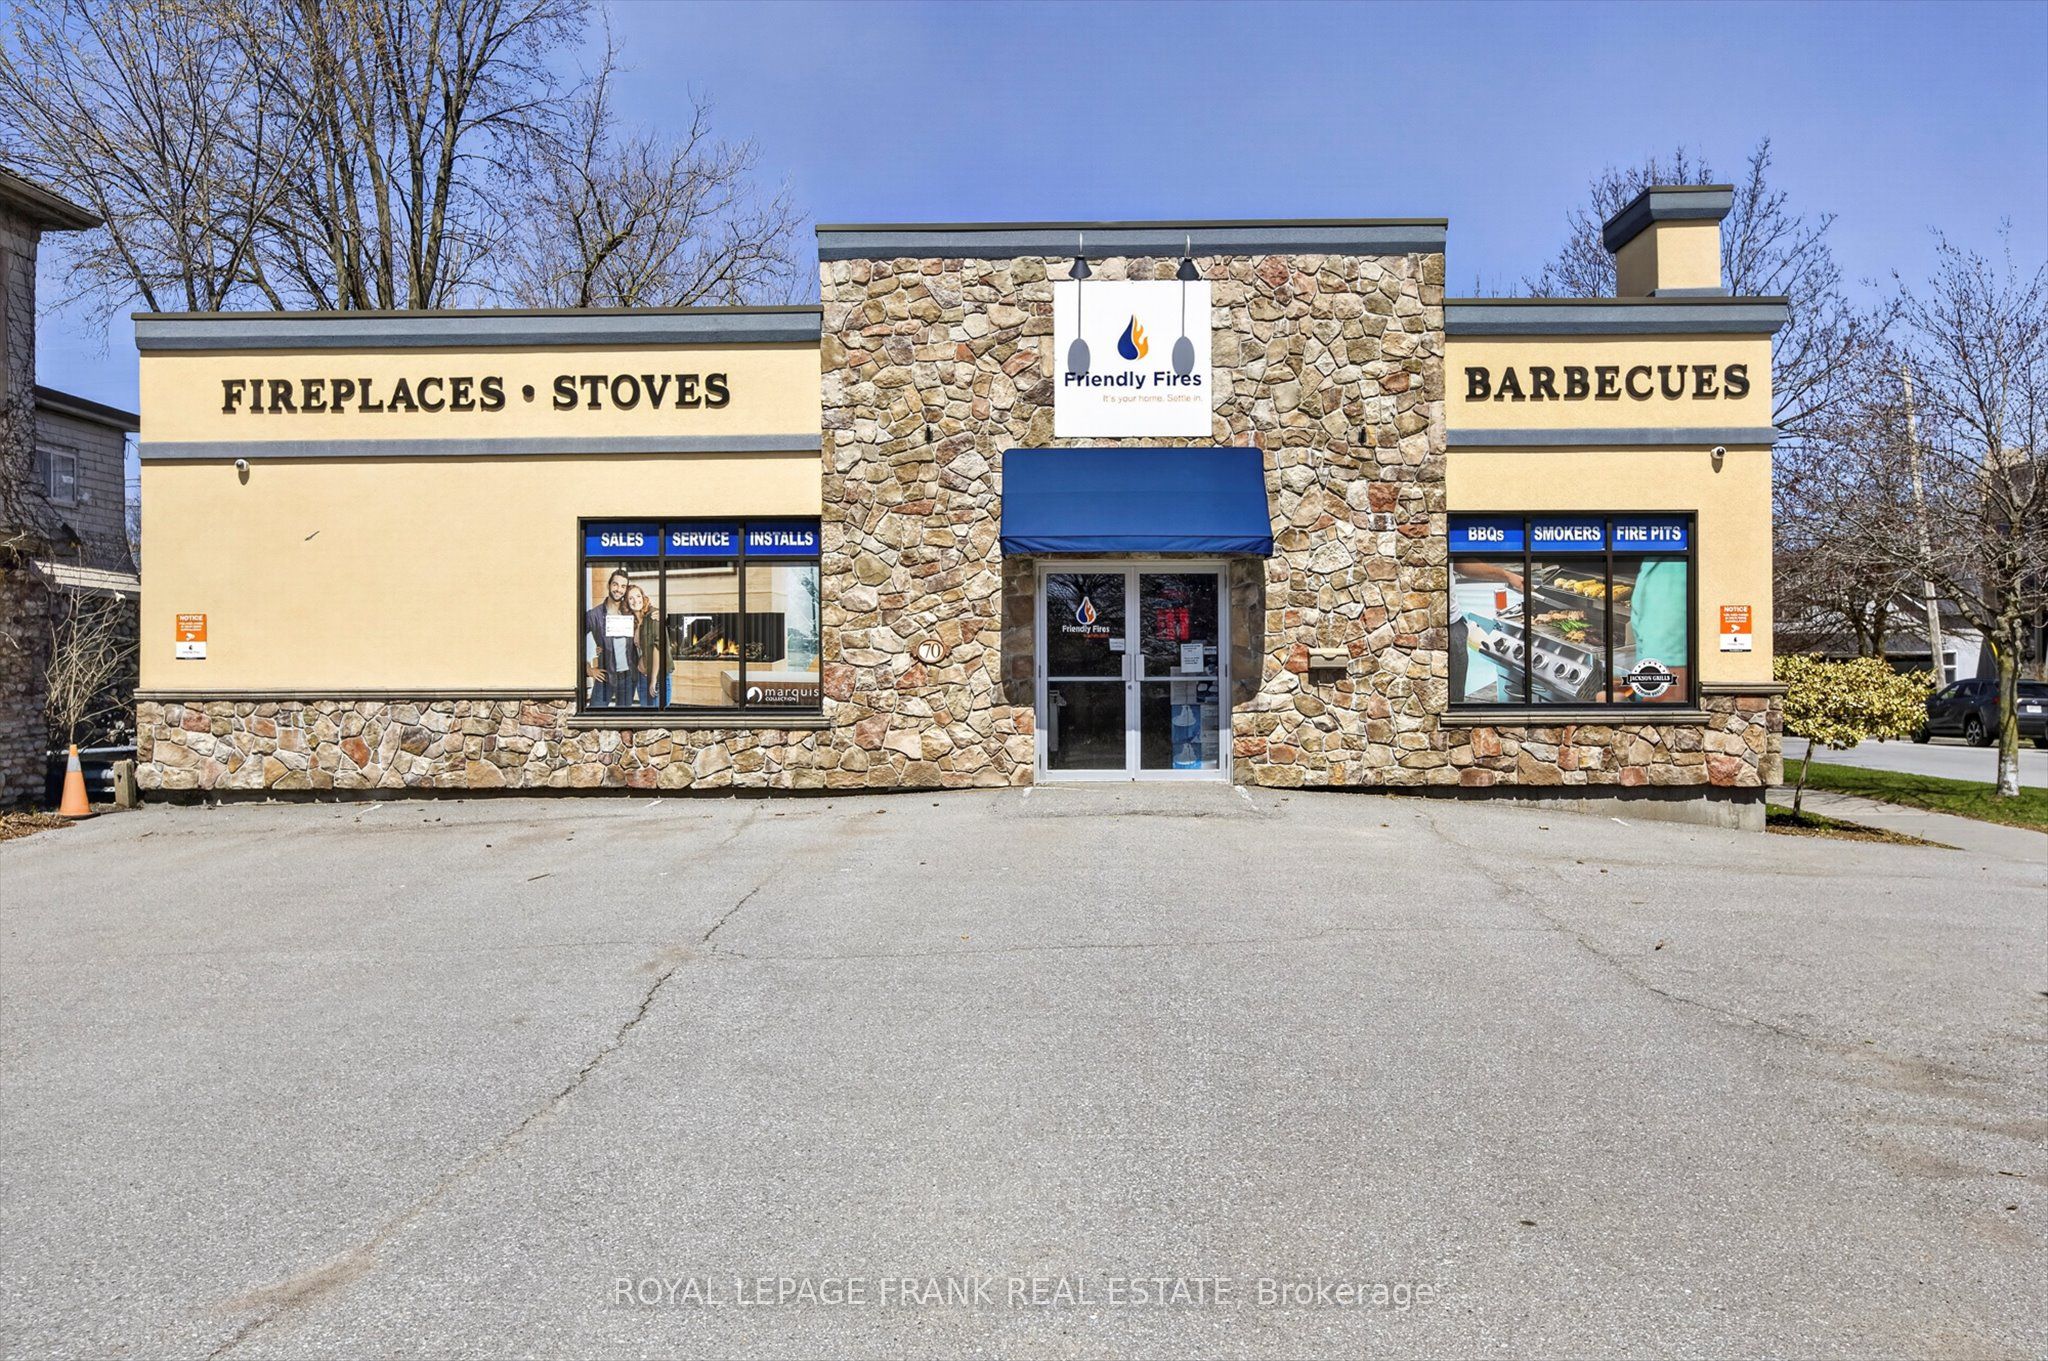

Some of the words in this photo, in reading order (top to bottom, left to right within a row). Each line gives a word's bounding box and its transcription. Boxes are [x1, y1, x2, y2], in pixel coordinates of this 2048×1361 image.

[1064, 371, 1146, 389] Friendly
[1153, 371, 1202, 387] Fires
[1464, 363, 1751, 402] BARBECUES
[220, 376, 506, 414] FIREPLACES
[552, 372, 731, 411] STOVES
[1102, 394, 1116, 403] It's
[1117, 395, 1137, 404] your
[1138, 394, 1164, 403] home.
[1166, 393, 1192, 402] Settle
[600, 532, 644, 547] SALES
[672, 531, 730, 547] SERVICE
[750, 531, 814, 547] INSTALLS
[1467, 526, 1505, 542] BBQs
[1534, 525, 1601, 541] SMOKERS
[1616, 525, 1648, 541] FIRE
[1651, 525, 1682, 541] PITS
[1062, 625, 1091, 634] Friendly
[1092, 625, 1110, 633] Fires
[922, 643, 940, 658] 70
[764, 688, 820, 703] marquis
